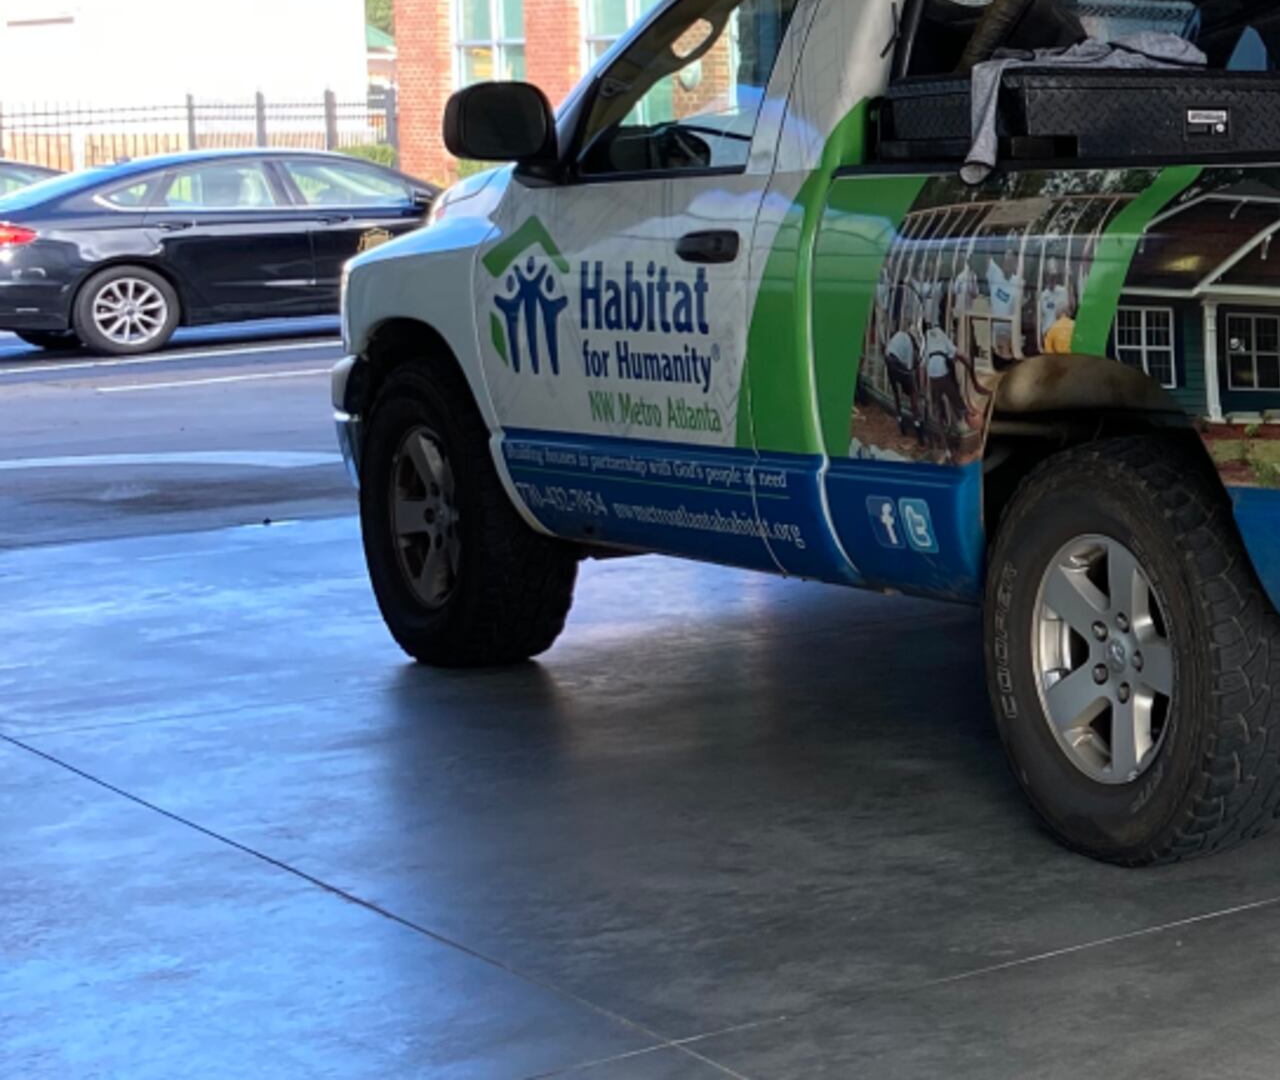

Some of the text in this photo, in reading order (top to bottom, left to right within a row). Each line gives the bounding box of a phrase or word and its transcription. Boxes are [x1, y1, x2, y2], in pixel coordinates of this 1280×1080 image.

[580, 260, 709, 335] Habitat
[583, 338, 609, 377] for
[588, 390, 723, 433] NW Metro Atlanta
[505, 442, 544, 466] Building
[545, 447, 577, 465] houses
[579, 451, 588, 467] in
[591, 454, 647, 477] partnership
[649, 460, 671, 476] with
[673, 460, 704, 480] God's
[706, 464, 741, 488] people
[759, 469, 787, 488] need
[994, 561, 1018, 719] COOPER
